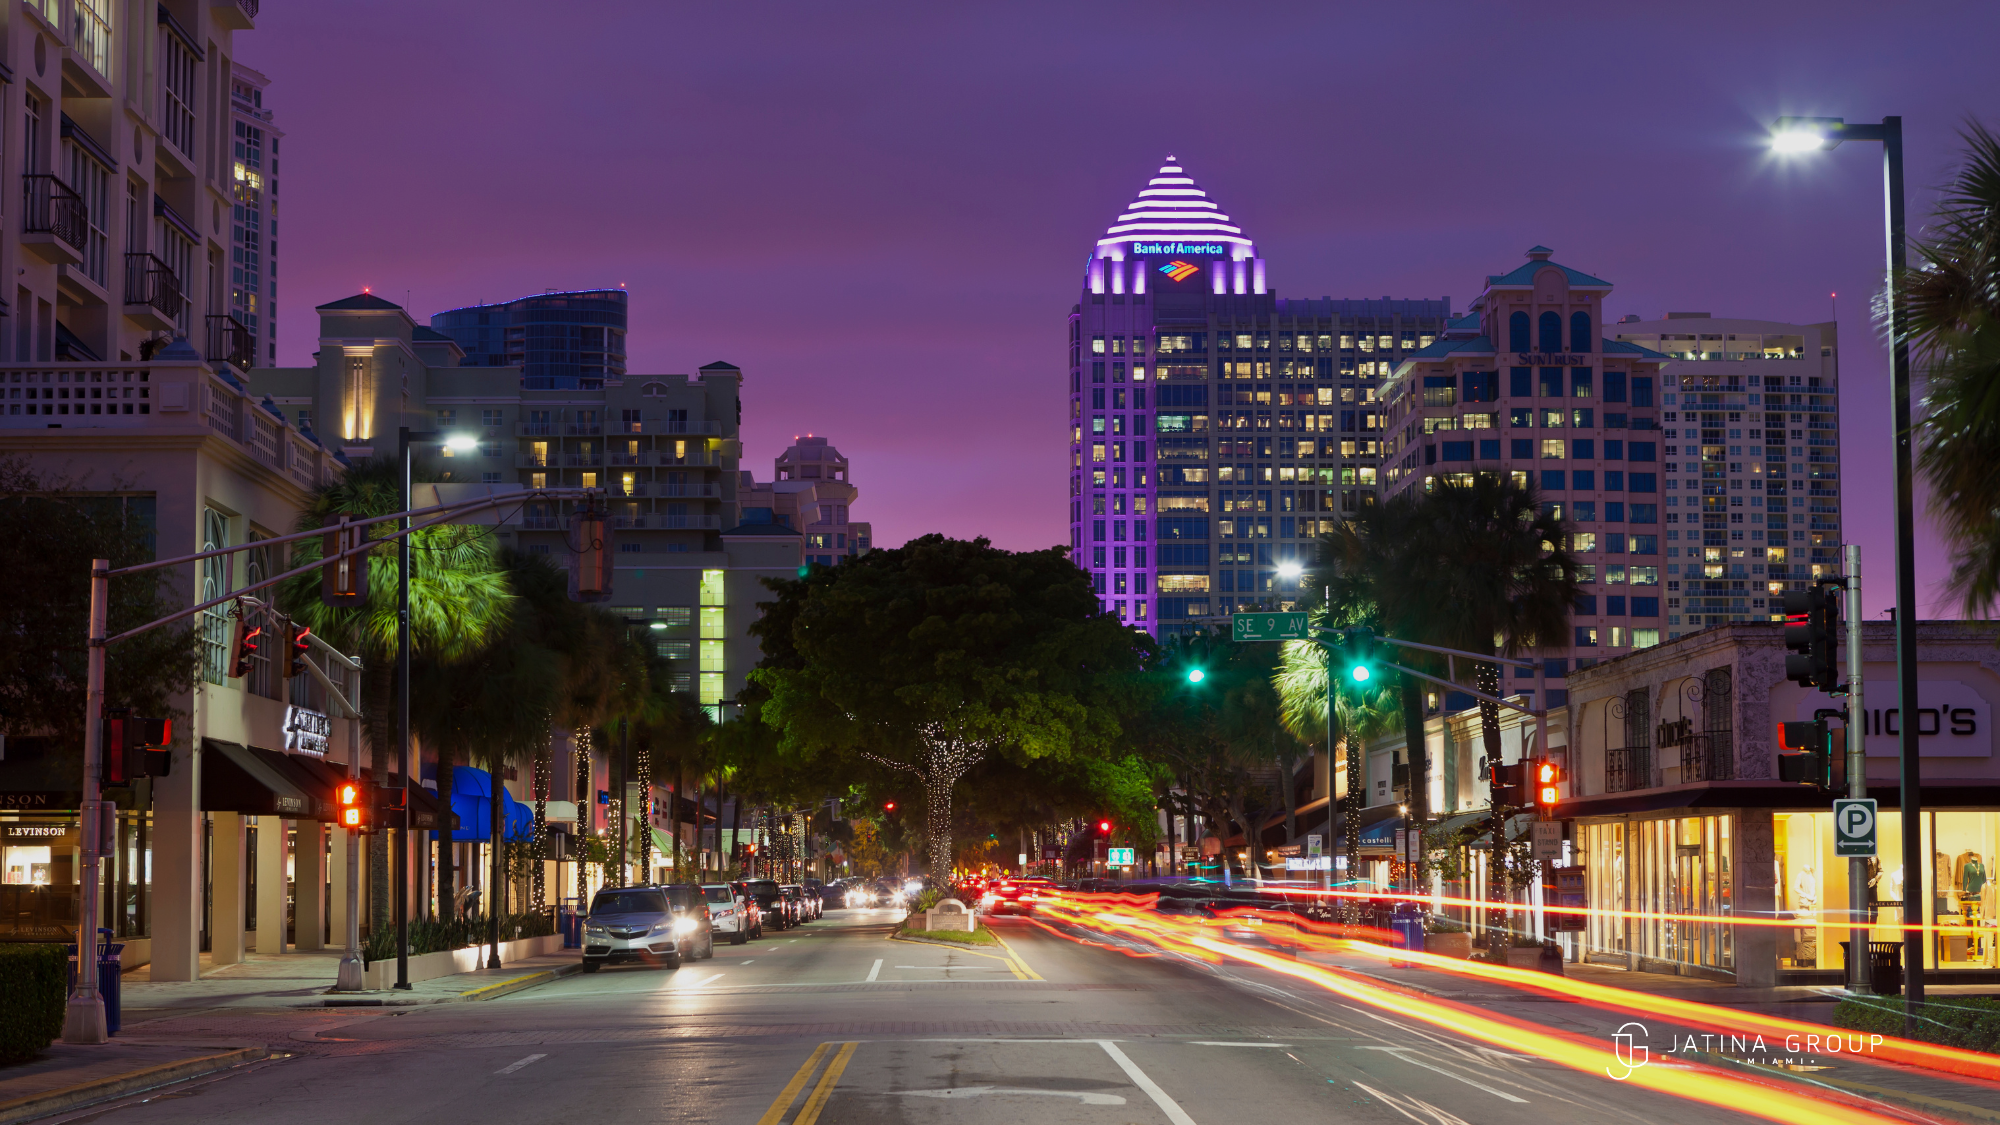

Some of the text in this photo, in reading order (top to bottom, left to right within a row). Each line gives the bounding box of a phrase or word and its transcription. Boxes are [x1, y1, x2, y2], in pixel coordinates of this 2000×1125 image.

[1133, 243, 1223, 254] Bank of America
[1238, 618, 1304, 632] SE 9 AV
[0, 795, 46, 804] SON
[1847, 810, 1867, 834] P
[8, 828, 66, 836] LEVINSON
